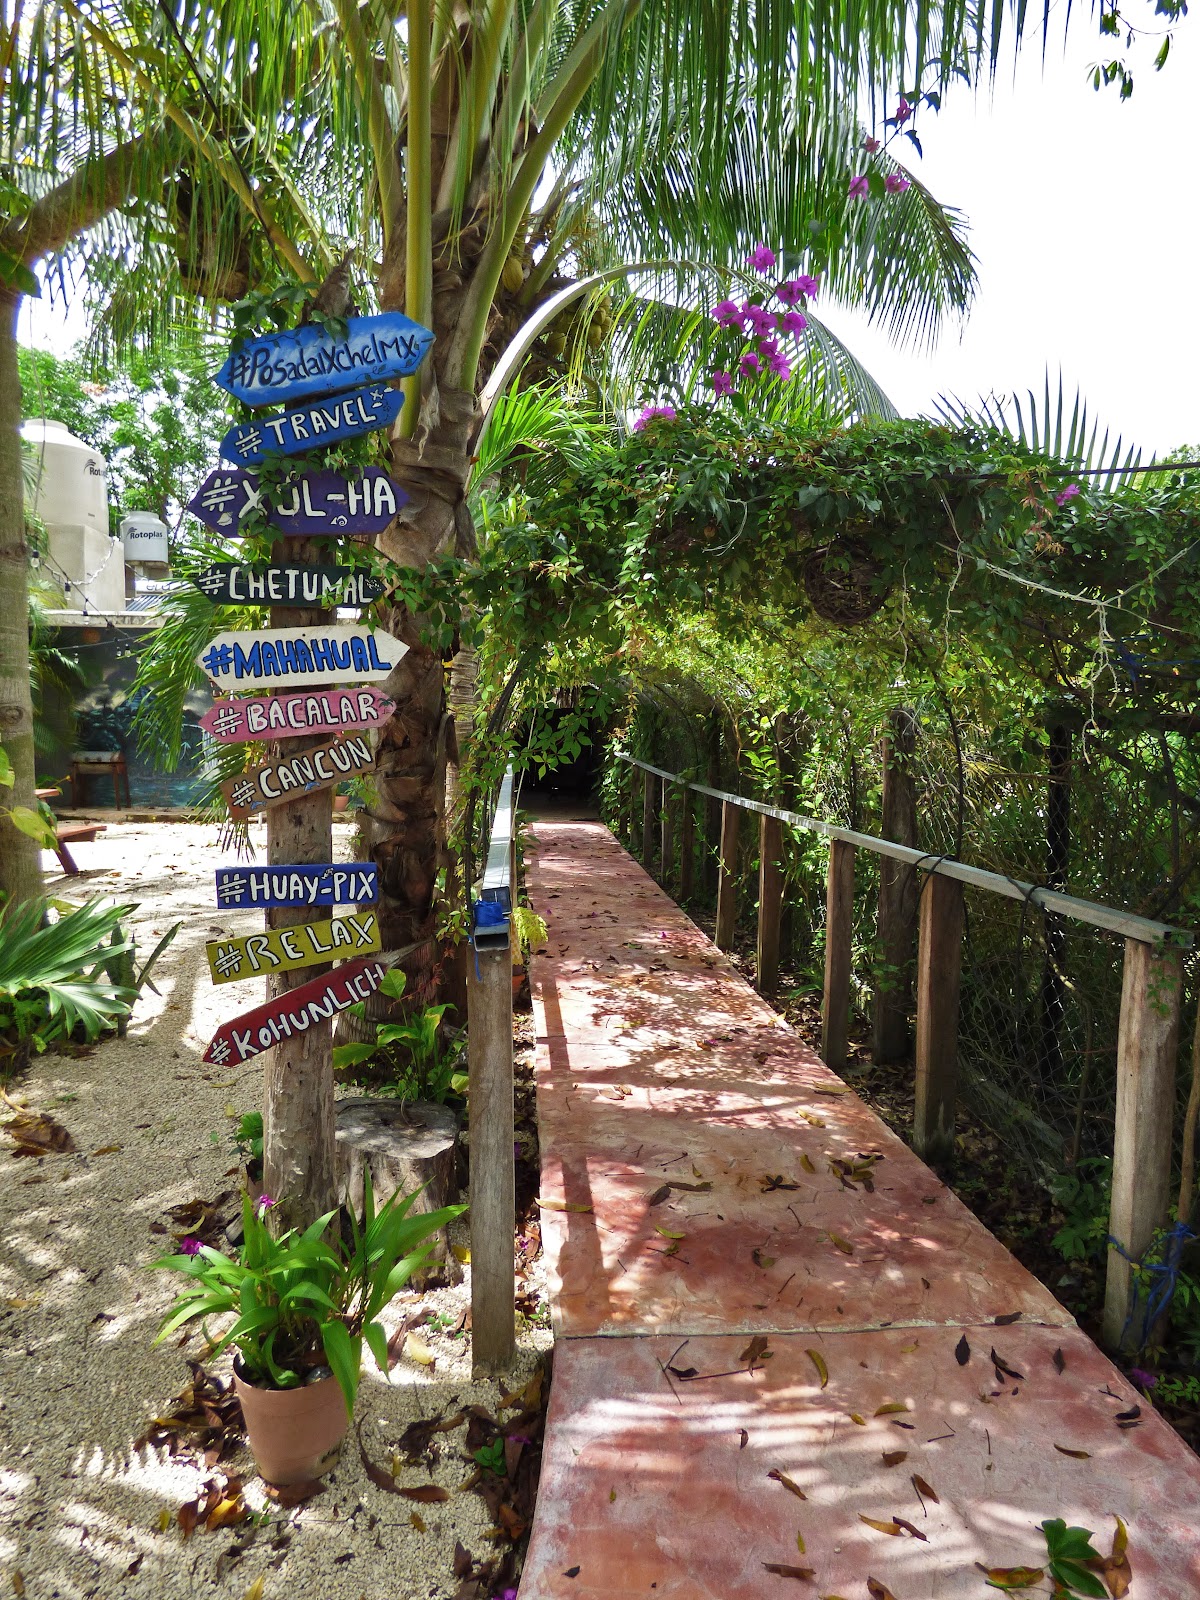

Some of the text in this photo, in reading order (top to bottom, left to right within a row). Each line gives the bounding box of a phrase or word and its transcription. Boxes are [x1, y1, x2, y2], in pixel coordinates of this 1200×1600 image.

[234, 397, 376, 458] #TRAVEL
[130, 531, 163, 540] Rotoplas
[198, 566, 373, 604] #CHETUMAL
[202, 635, 393, 679] #MAHAHUAL
[212, 692, 380, 737] #BACALAR
[230, 736, 374, 808] #CANCÚN
[217, 871, 376, 904] #HUAY-PIX
[214, 915, 375, 978] #RELAX
